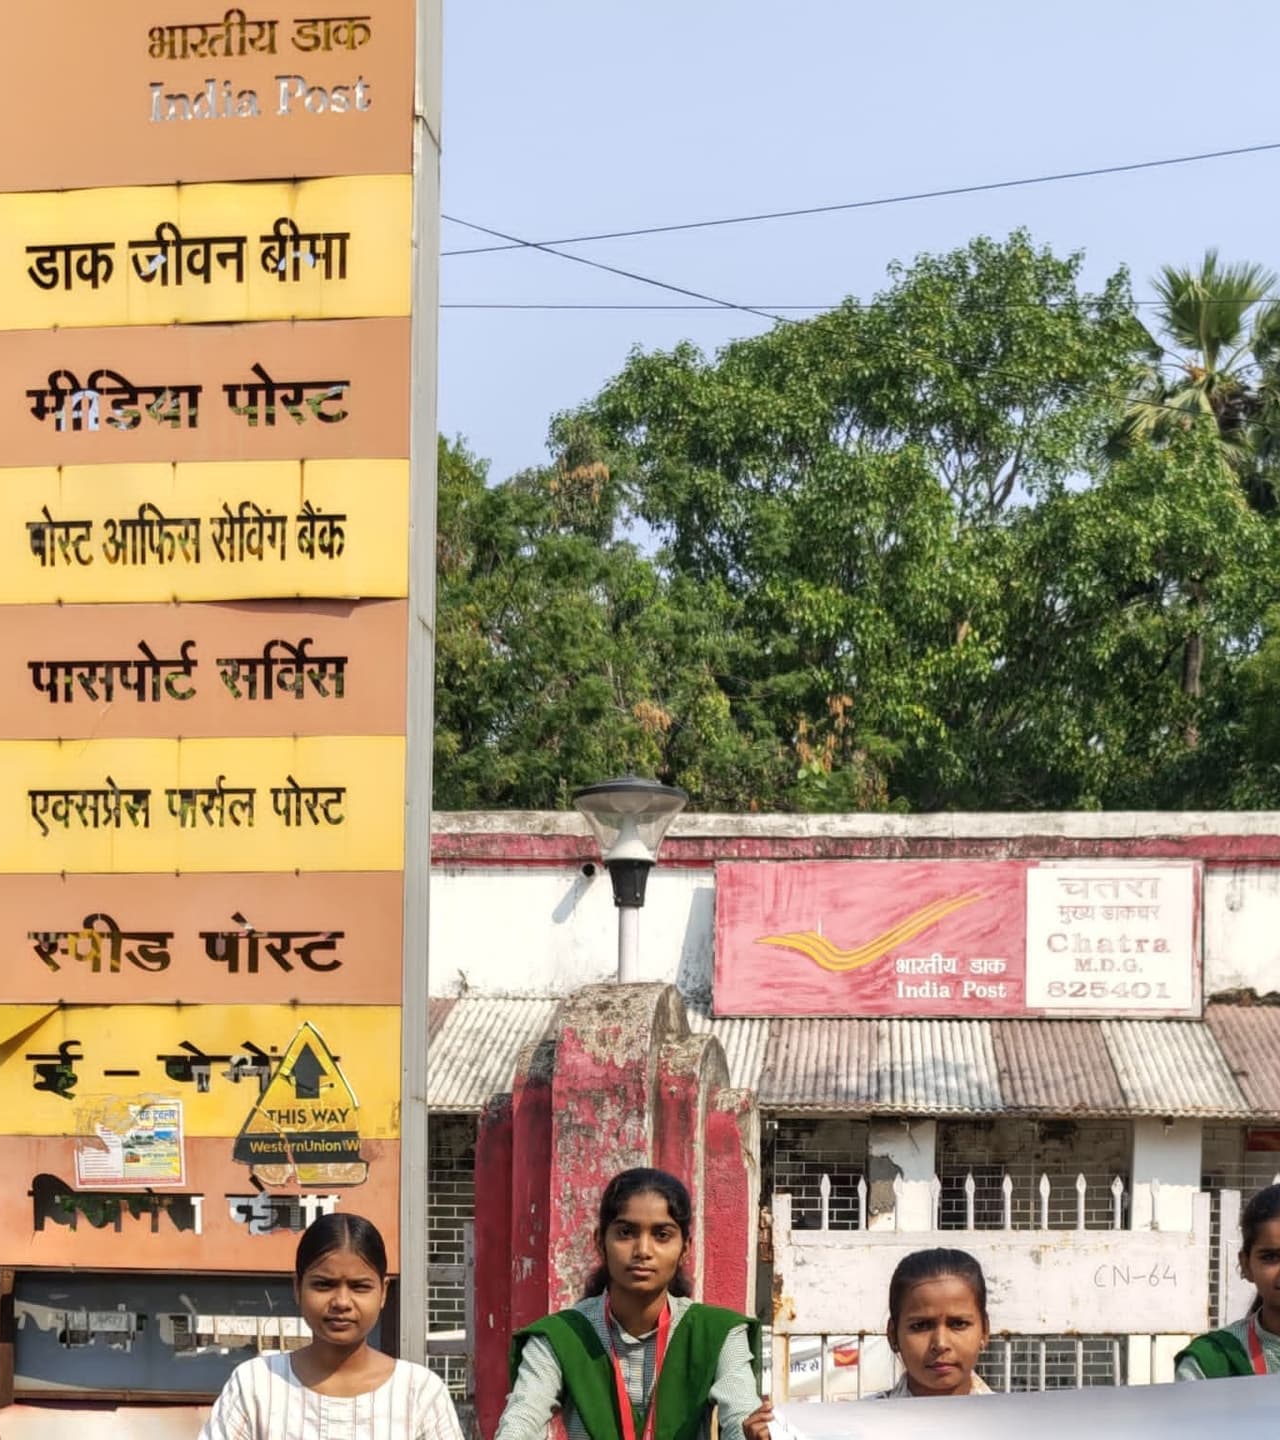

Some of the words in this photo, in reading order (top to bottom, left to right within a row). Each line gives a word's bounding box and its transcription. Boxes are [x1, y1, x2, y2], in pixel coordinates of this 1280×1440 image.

[148, 8, 278, 60] भारतीय
[291, 16, 371, 54] डाक
[148, 78, 260, 123] India
[275, 74, 372, 115] Post
[26, 242, 115, 291] डाक
[128, 221, 247, 287] जीवन
[260, 216, 350, 282] बीमा
[26, 368, 202, 433] मीडिया
[223, 362, 351, 428] पोस्ट
[102, 501, 201, 566] आफिस
[210, 501, 287, 564] सेविंग
[297, 500, 347, 560] बैंक
[28, 640, 198, 703] पासपोर्ट
[217, 637, 348, 700] सर्विस
[28, 775, 151, 837] एक्सप्रेस
[270, 775, 346, 827] पोस्ट
[1057, 877, 1160, 900] चतरा
[28, 912, 174, 974] स्पीड
[199, 911, 344, 974] पोस्ट
[1047, 932, 1172, 954] Chatra
[896, 954, 957, 976] भारतीय
[970, 958, 1006, 976] डाक
[1074, 958, 1144, 974] M.D.G.
[897, 980, 952, 1000] India
[962, 979, 1007, 999] Post
[1047, 981, 1172, 999] 825401
[268, 1109, 306, 1124] THIS
[312, 1108, 349, 1124] WAY
[1094, 1263, 1178, 1288] CN-64
